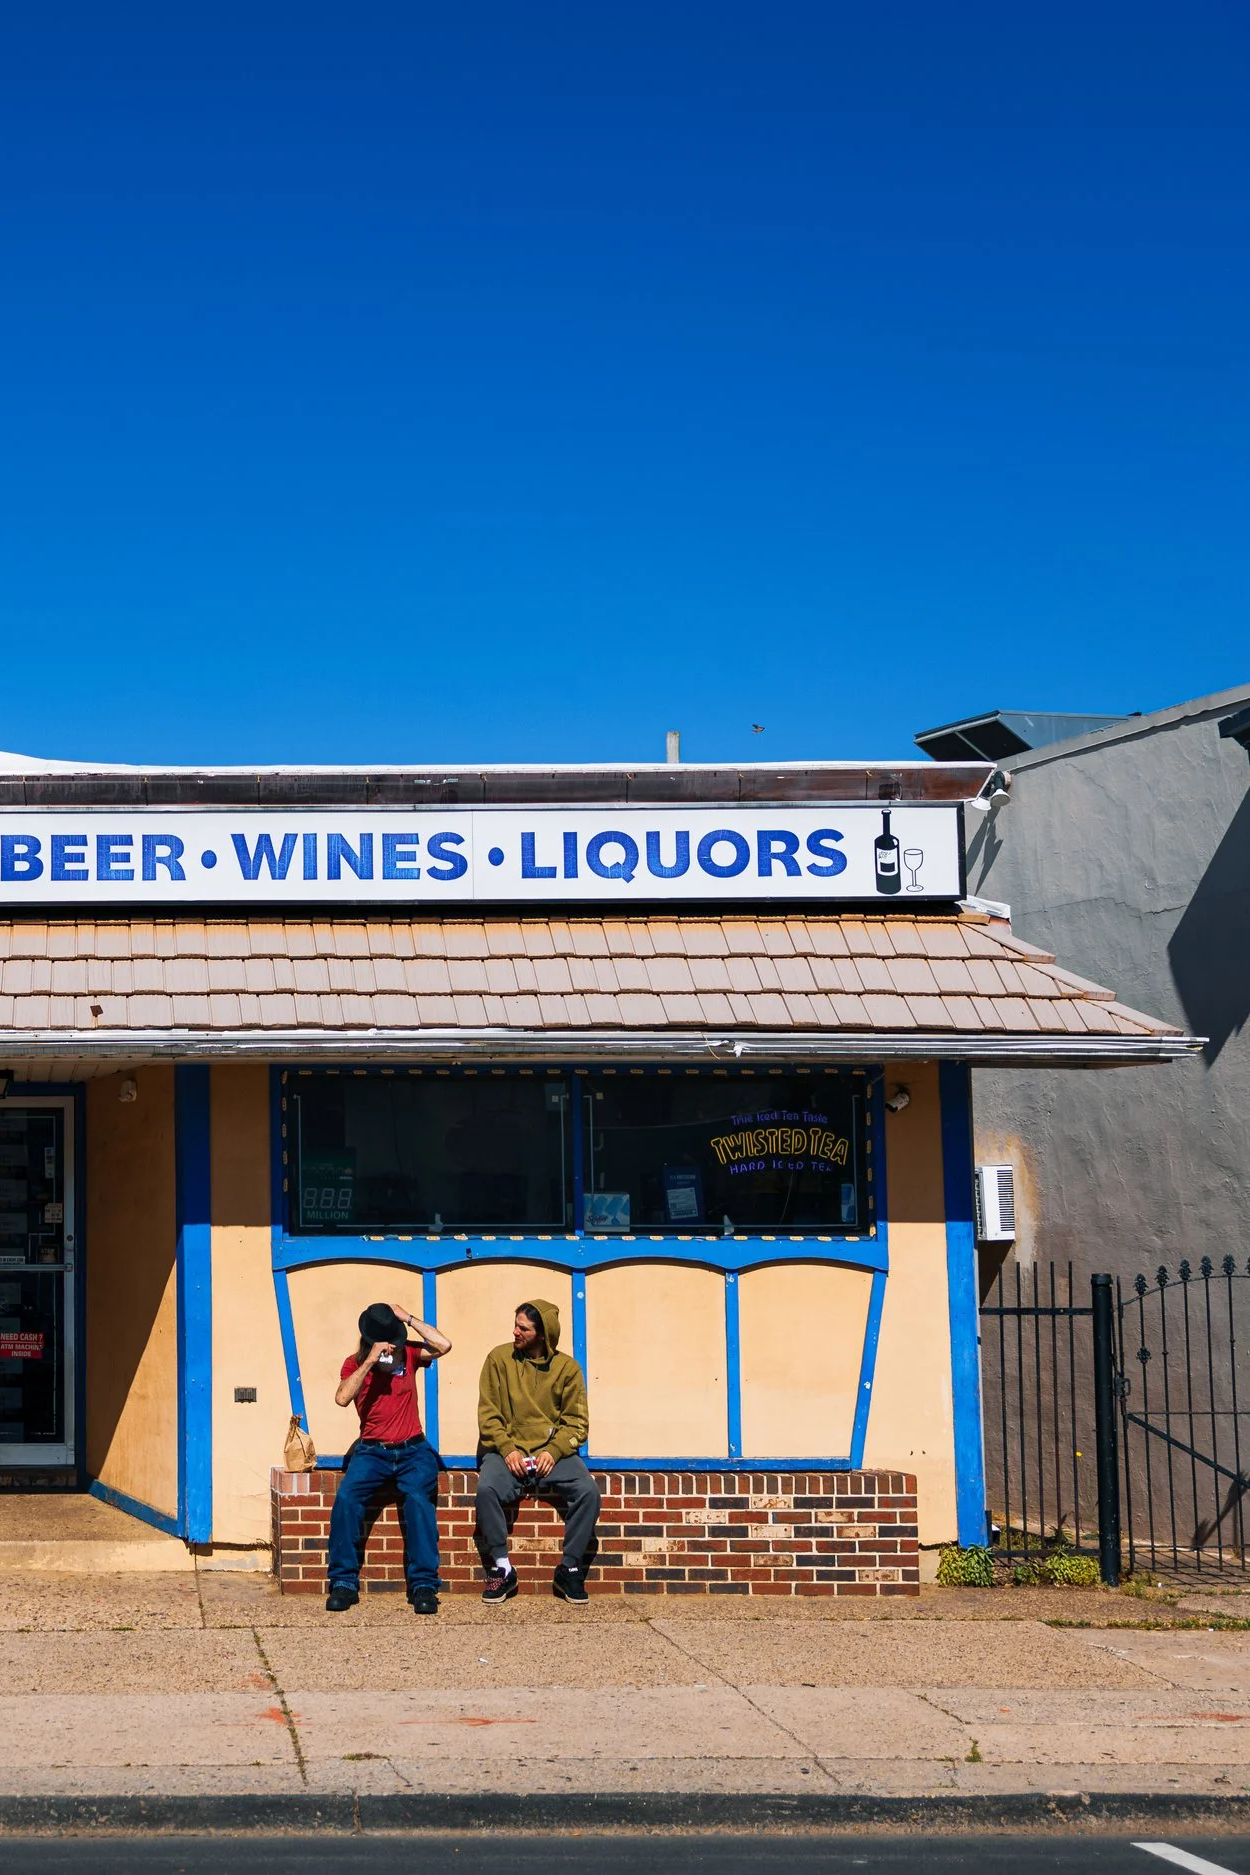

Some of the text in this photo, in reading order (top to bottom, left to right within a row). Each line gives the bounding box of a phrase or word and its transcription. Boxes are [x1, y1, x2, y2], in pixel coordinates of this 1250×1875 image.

[0, 833, 187, 882] BEER
[230, 831, 469, 881] WINES
[520, 828, 848, 884] LIQUORS
[757, 1111, 778, 1121] Iced
[781, 1110, 800, 1120] Tea
[710, 1127, 849, 1167] TWISTED TEA
[729, 1161, 766, 1175] HARD
[307, 1211, 349, 1220] MILLION
[0, 1333, 19, 1341] NEED
[20, 1333, 38, 1341] CASH
